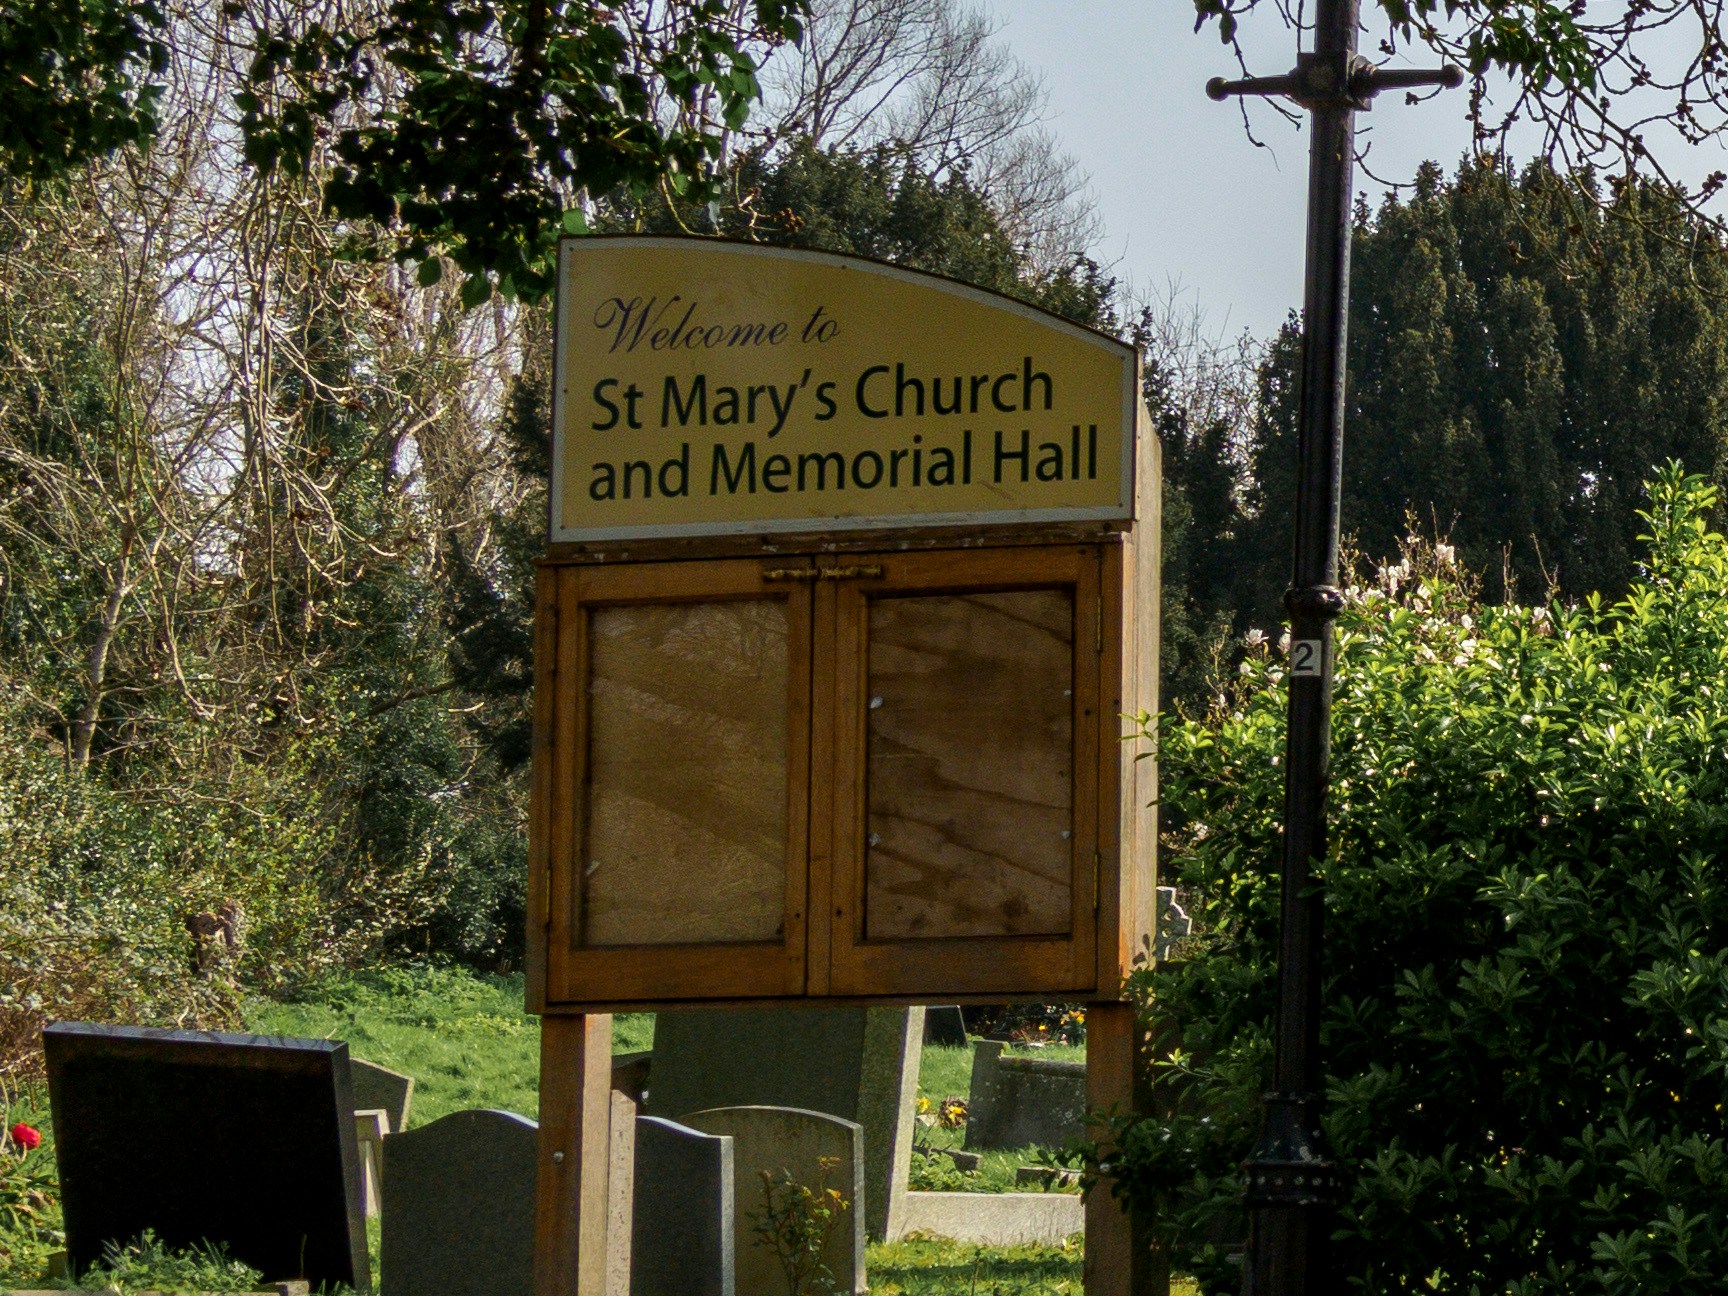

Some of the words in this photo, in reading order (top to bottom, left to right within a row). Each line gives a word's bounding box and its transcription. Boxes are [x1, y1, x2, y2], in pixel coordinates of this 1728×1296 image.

[592, 295, 788, 354] Welcome
[800, 306, 840, 344] to
[590, 376, 643, 431] St
[660, 367, 837, 438] Mary's
[854, 356, 1053, 419] Church
[589, 442, 690, 500] and
[709, 430, 972, 496] Memorial
[993, 424, 1098, 484] Hall
[1294, 642, 1313, 671] 2
